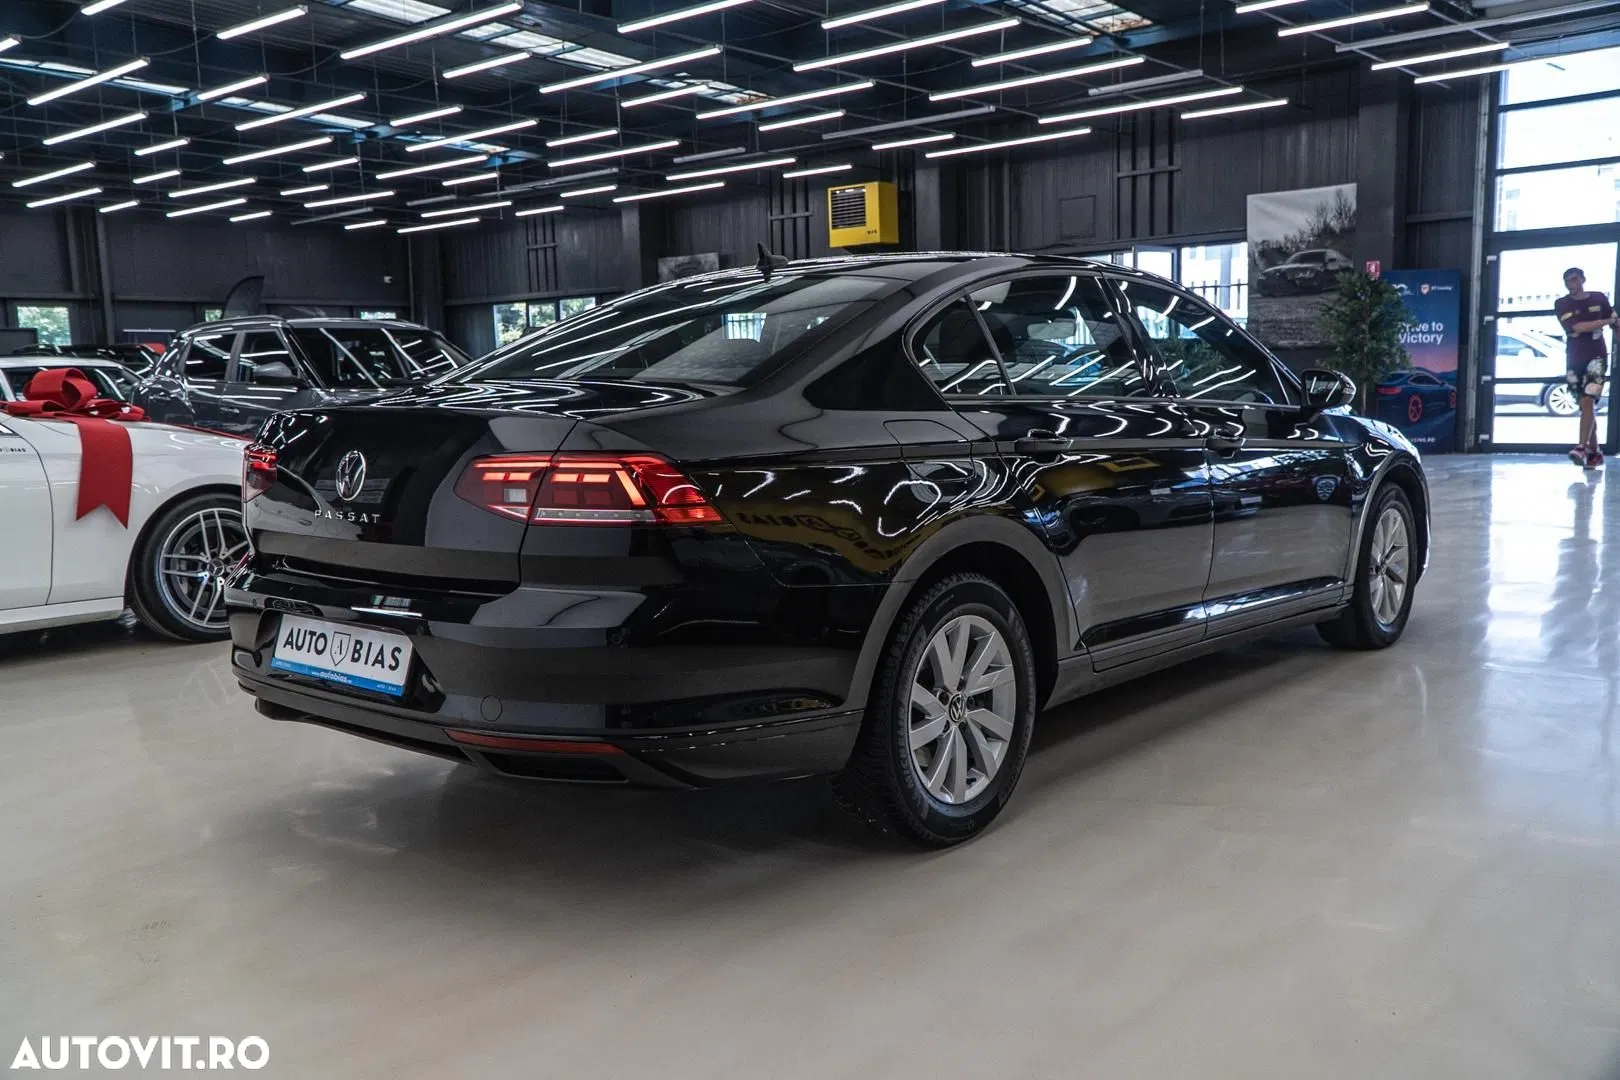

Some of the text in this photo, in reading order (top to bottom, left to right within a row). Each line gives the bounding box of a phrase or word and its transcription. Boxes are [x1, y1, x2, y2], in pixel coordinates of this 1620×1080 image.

[1431, 321, 1444, 332] to
[1398, 332, 1444, 345] Victory
[314, 510, 381, 523] PASSAT
[283, 627, 402, 671] AUTO BIAS
